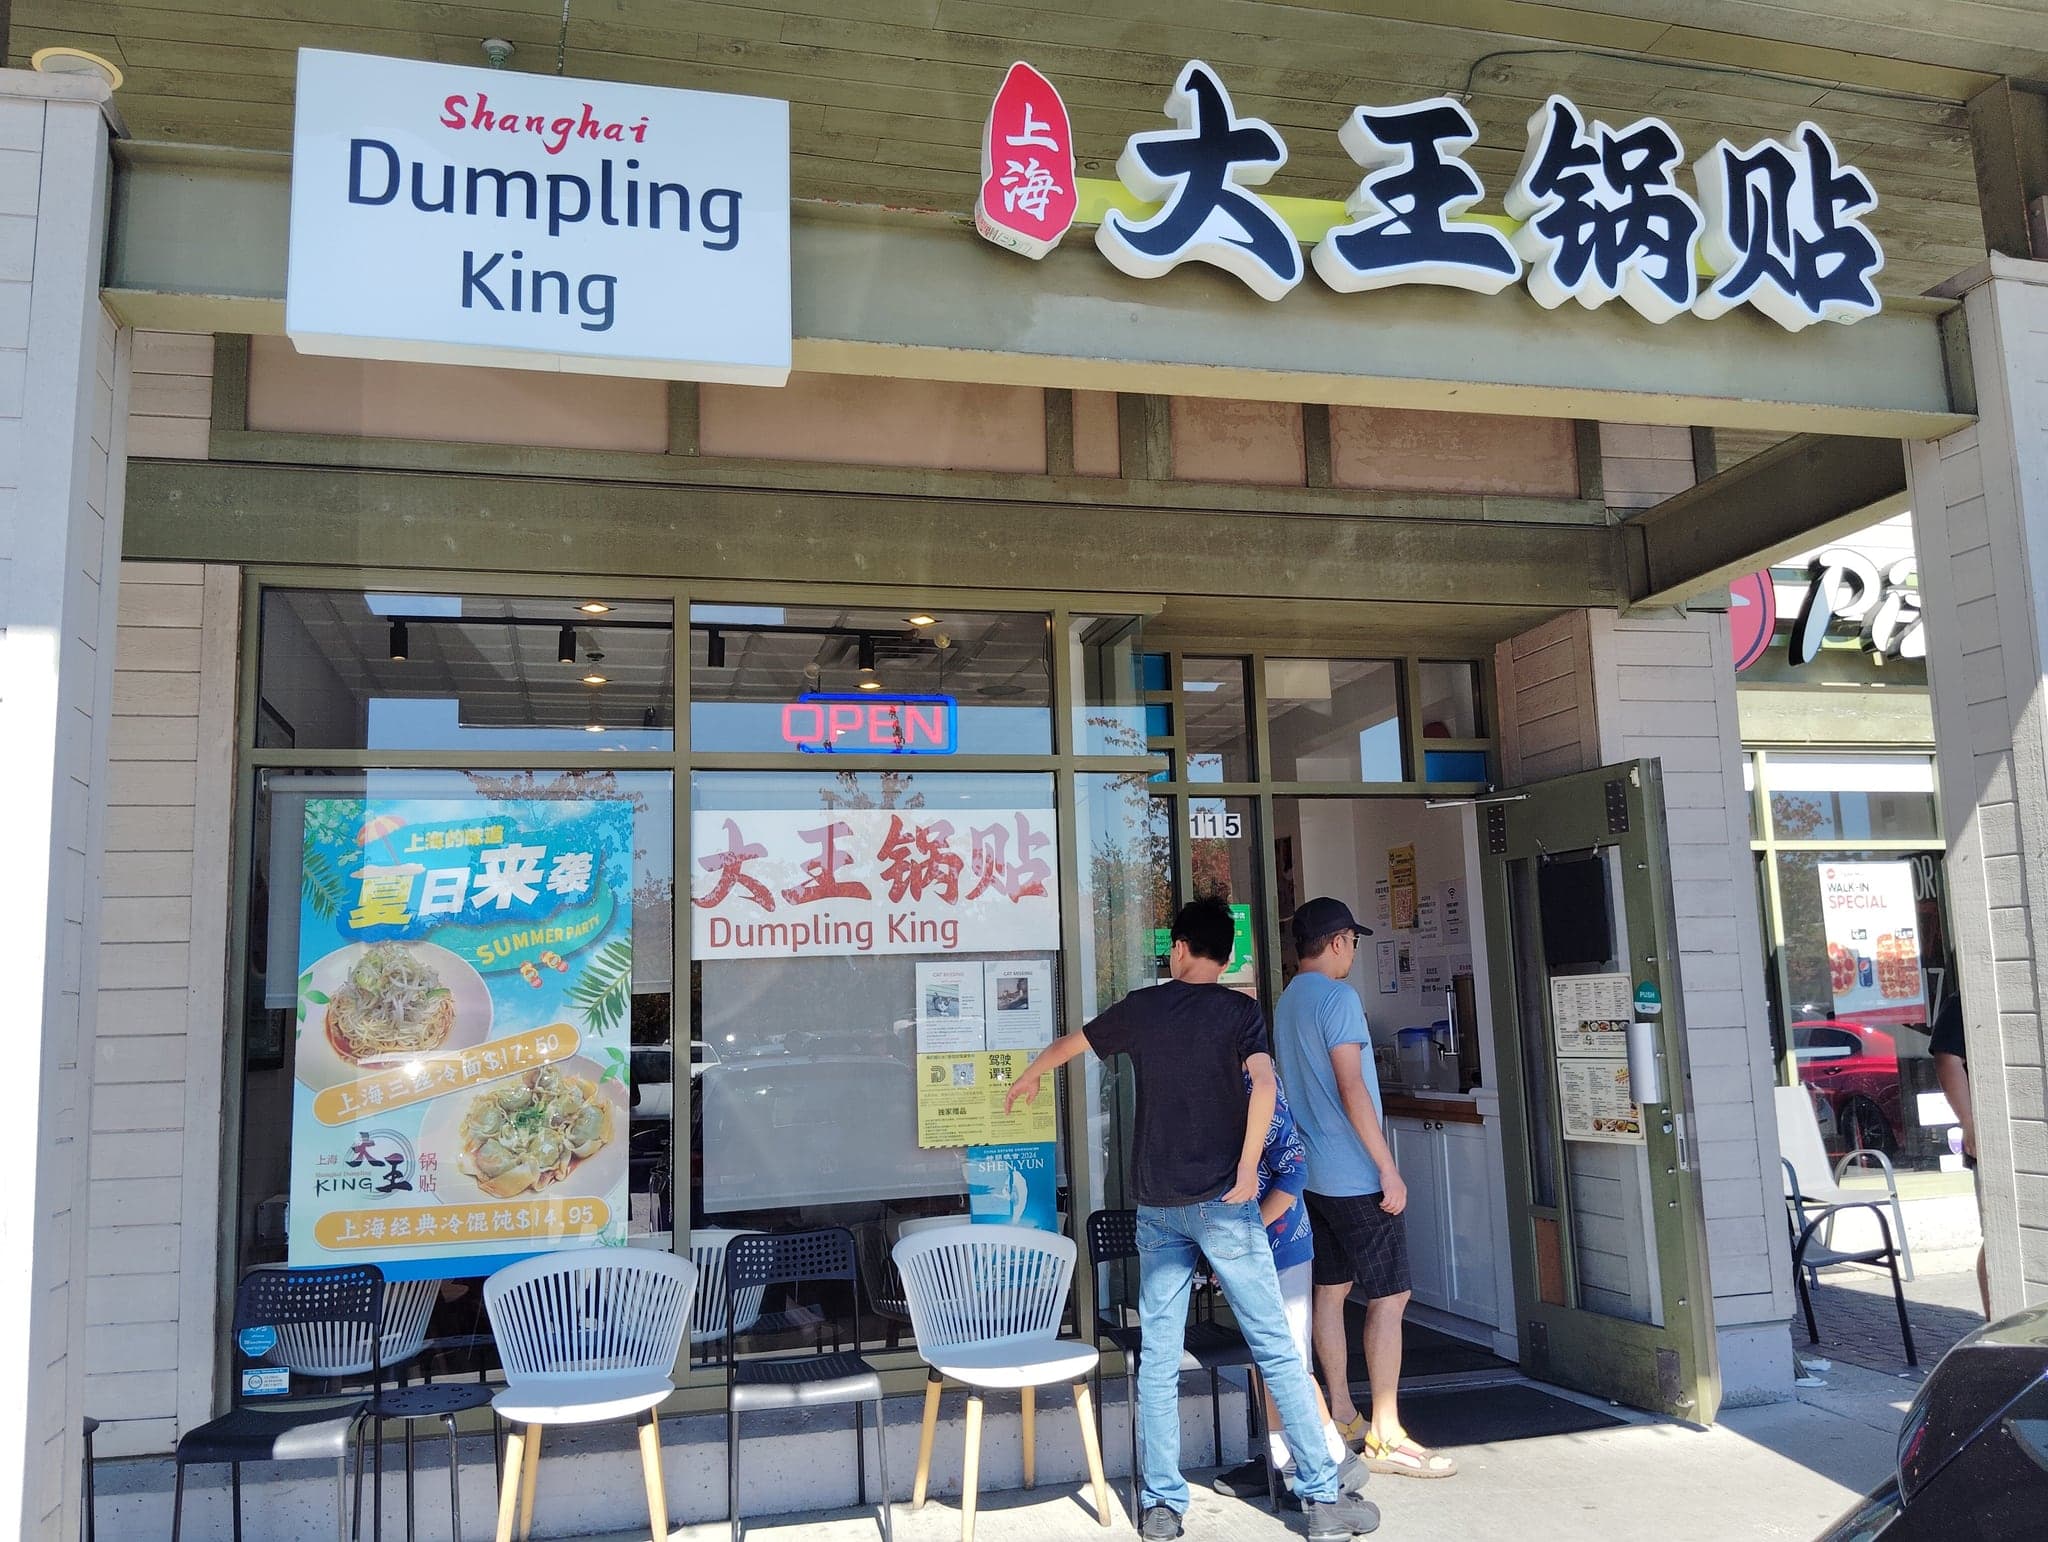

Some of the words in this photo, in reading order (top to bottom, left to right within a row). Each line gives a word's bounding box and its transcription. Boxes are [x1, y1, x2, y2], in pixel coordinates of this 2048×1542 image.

[440, 92, 650, 155] Shanghai
[1000, 102, 1065, 221] 上海
[348, 138, 743, 251] Dumpling
[1108, 68, 1878, 315] 大王锅贴
[461, 249, 618, 332] King
[781, 703, 943, 745] OPEN
[1190, 815, 1240, 837] 115
[690, 810, 1052, 913] 大王锅贴
[348, 843, 594, 929] 夏日来袭
[1827, 882, 1870, 893] WALK-IN
[1827, 895, 1888, 910] SPECIAL
[476, 926, 564, 966] SUMMER
[565, 913, 601, 941] PARTY
[709, 912, 873, 951] Dumpling
[888, 911, 959, 949] King
[1639, 991, 1656, 999] PUSH
[315, 1177, 373, 1197] KING
[979, 1159, 1014, 1172] SHEN
[1016, 1158, 1045, 1169] YUN
